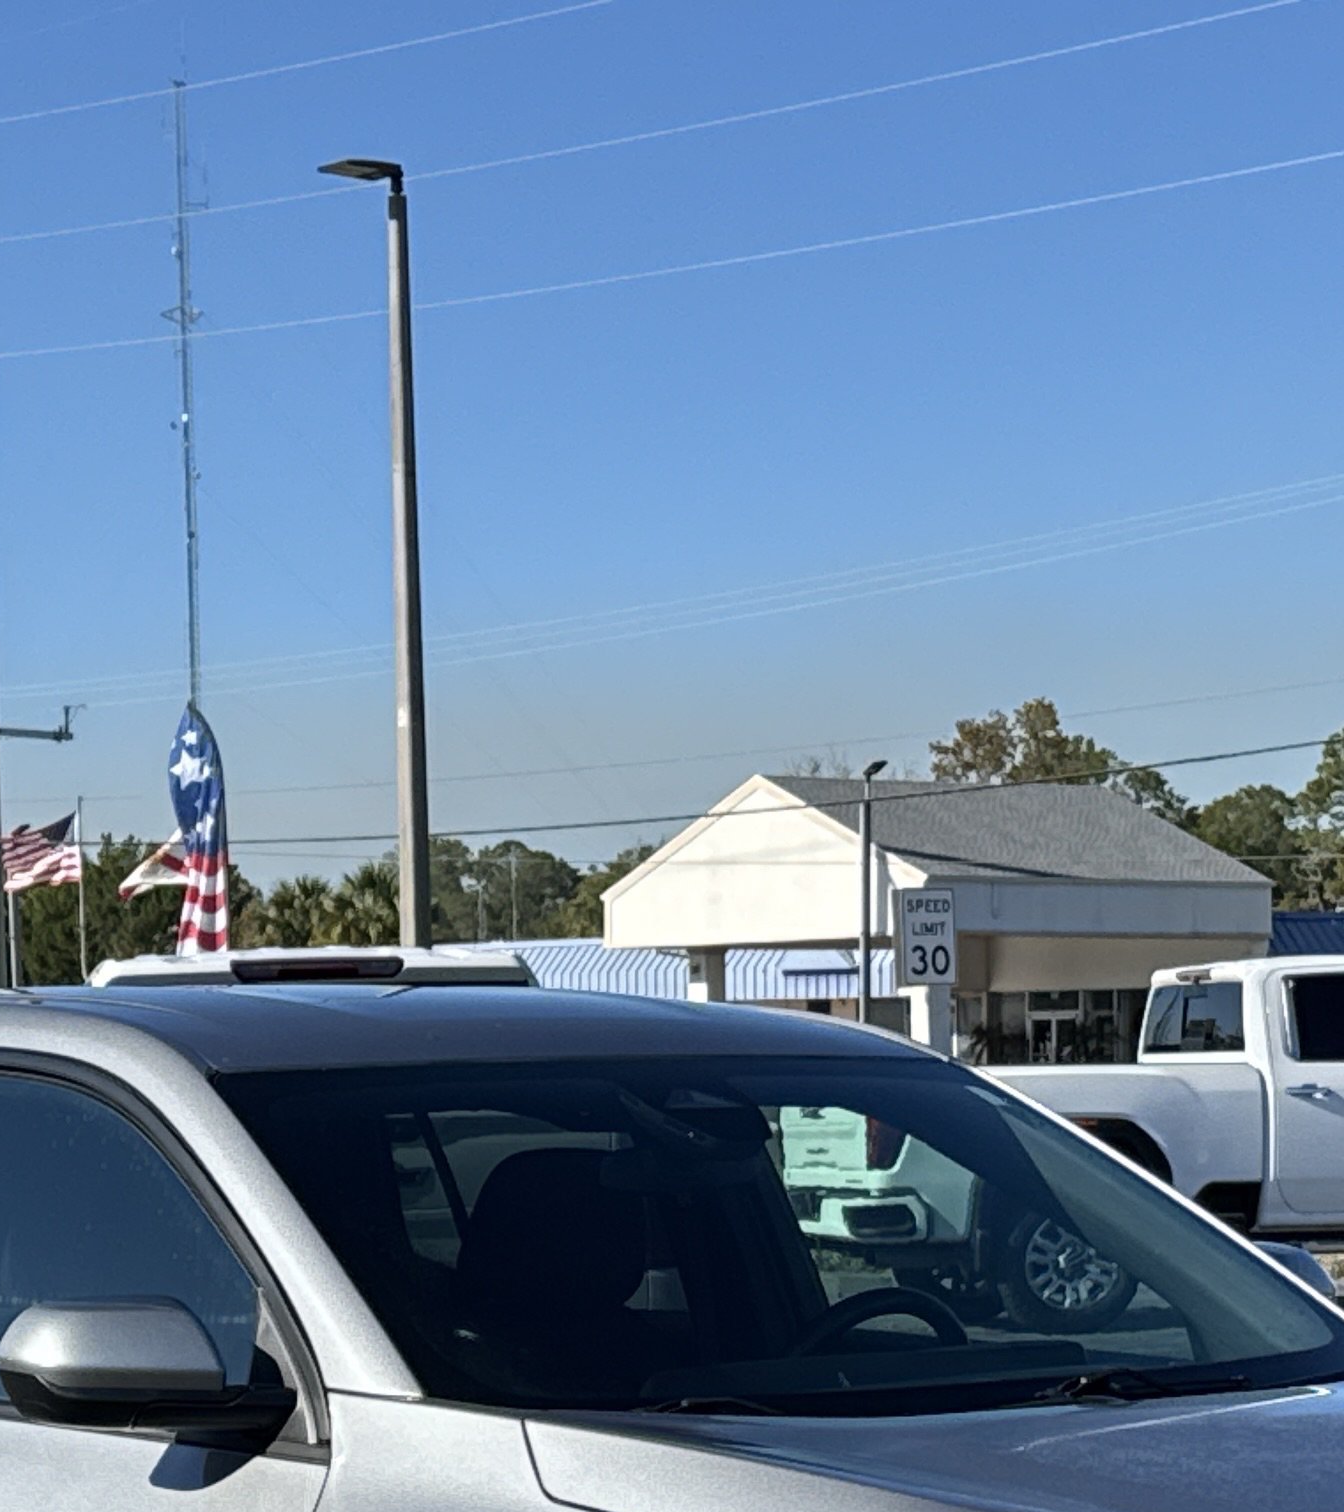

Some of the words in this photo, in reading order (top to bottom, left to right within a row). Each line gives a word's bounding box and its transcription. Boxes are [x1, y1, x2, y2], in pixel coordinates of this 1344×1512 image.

[907, 898, 950, 913] SPEED
[912, 921, 946, 936] LIMIT
[911, 944, 950, 976] 30
